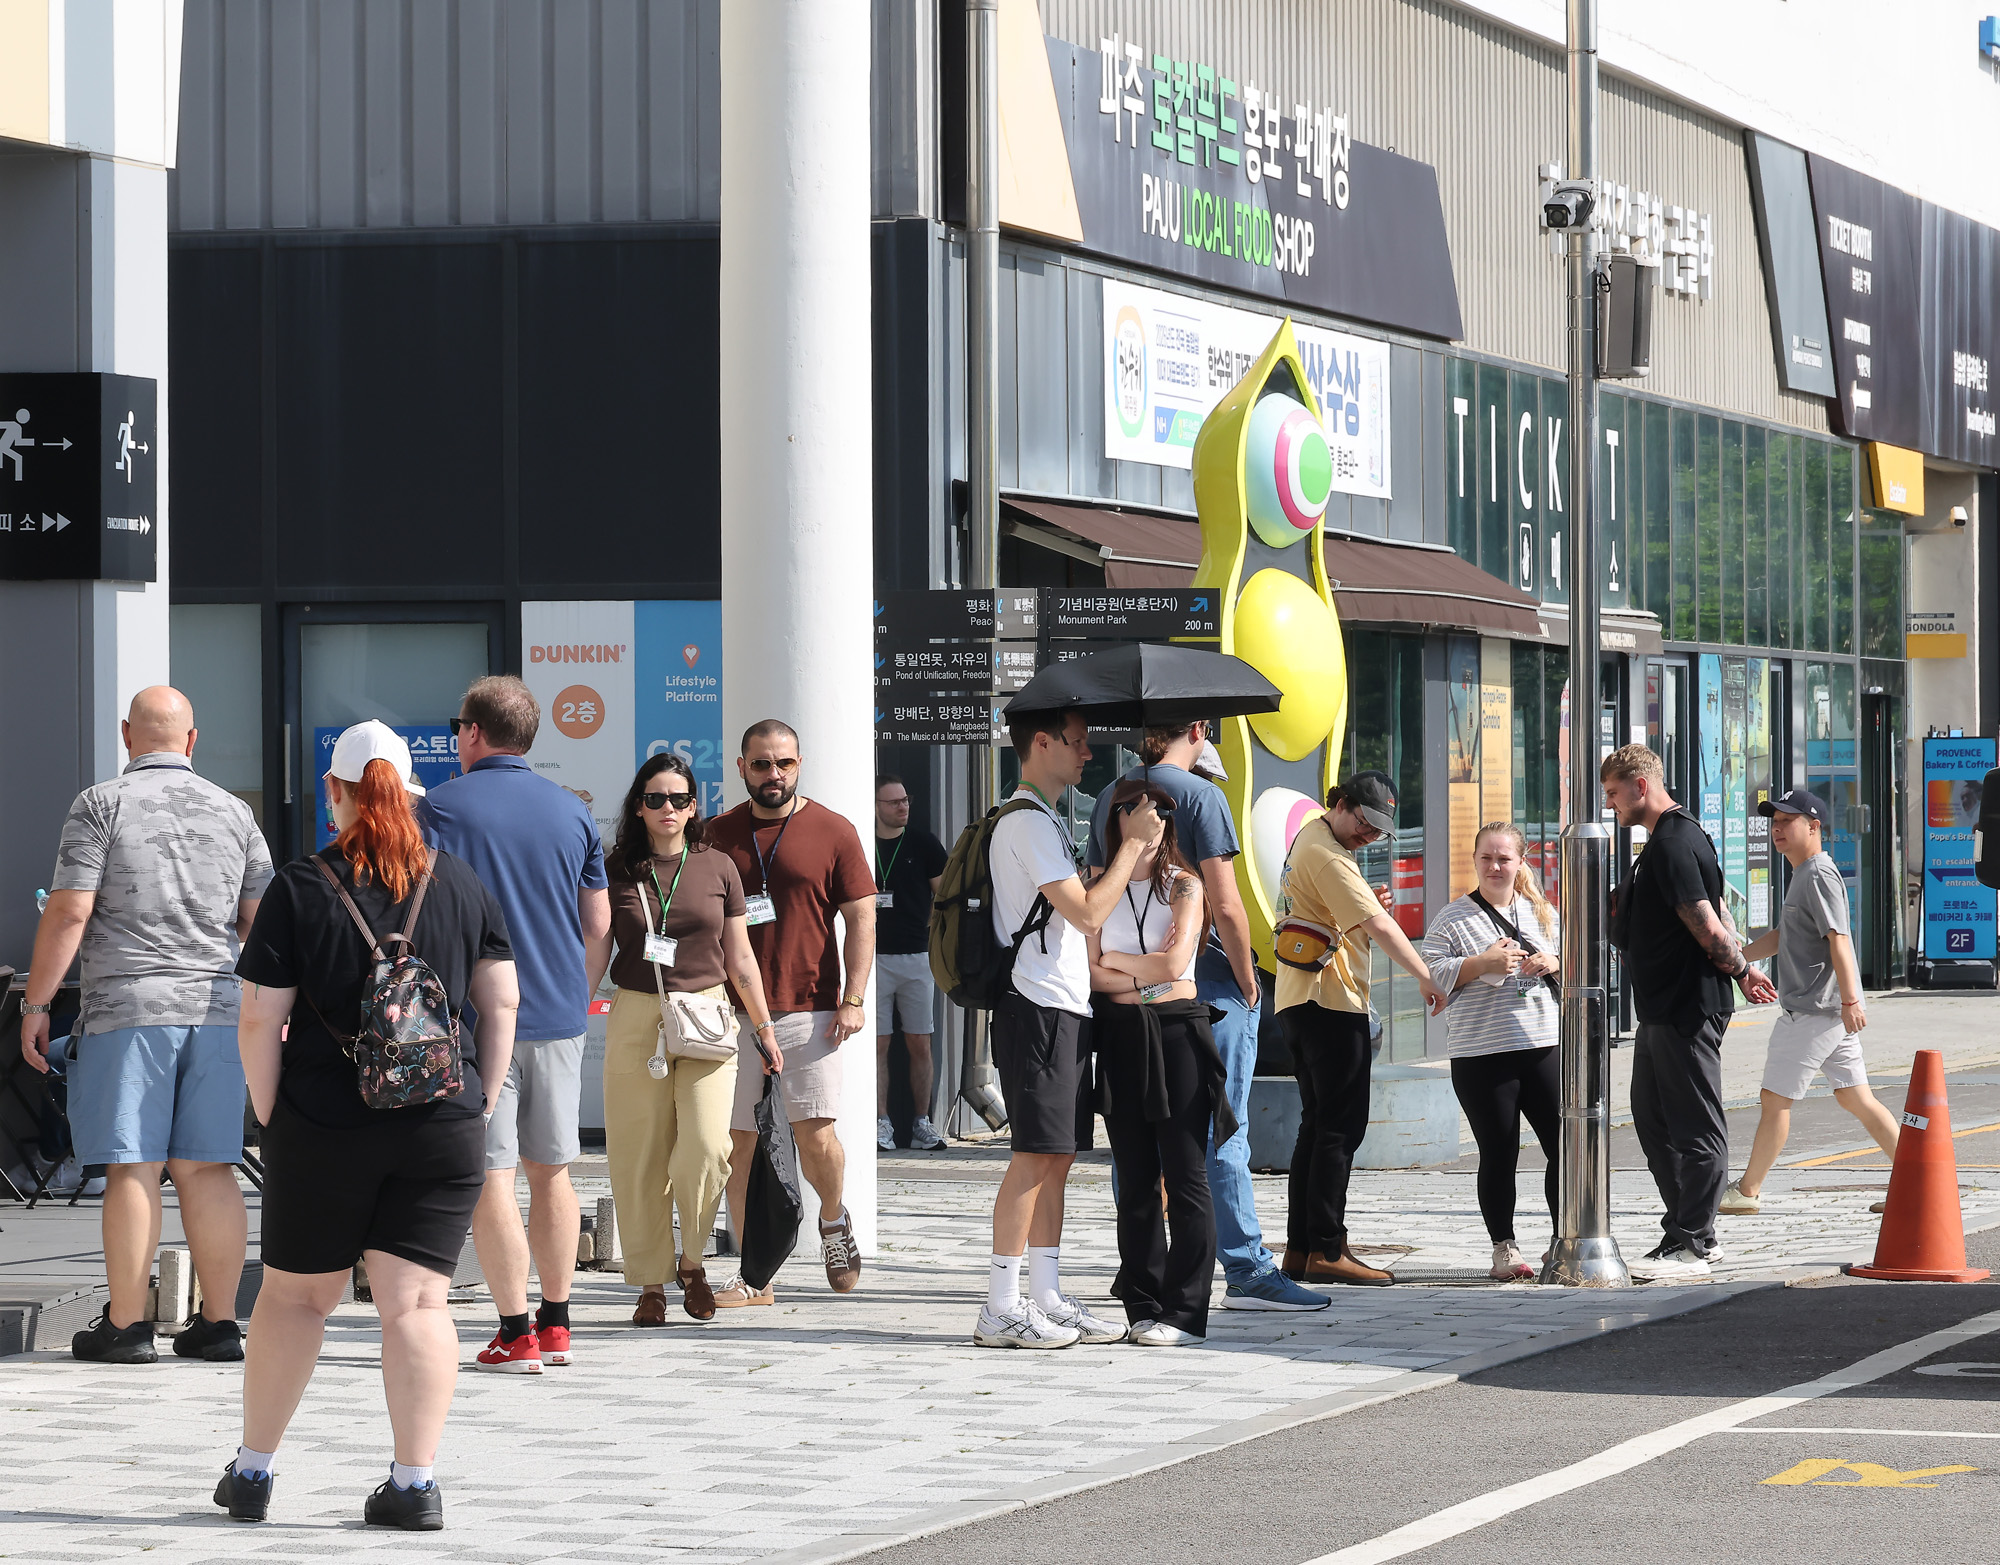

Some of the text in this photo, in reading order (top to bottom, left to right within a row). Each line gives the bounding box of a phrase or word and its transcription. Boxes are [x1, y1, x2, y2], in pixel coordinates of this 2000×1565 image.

[1099, 33, 1145, 149] 파주
[1151, 53, 1240, 168] 로컬푸드
[1141, 172, 1315, 277] PAJU LOCAL FOOD SHOP
[1207, 344, 1233, 390] 한수위
[1298, 339, 1361, 437] 상수상
[1156, 416, 1167, 434] NH
[1453, 396, 1619, 521] TICKT
[1551, 531, 1619, 592] 매소
[966, 599, 993, 614] 평화
[1058, 597, 1178, 612] 기념비공원(보훈단지)
[970, 616, 993, 626] Peac
[1058, 615, 1127, 625] Monument Park
[1184, 620, 1213, 631] 200 m
[1905, 622, 1955, 632] GONDOLA
[529, 644, 627, 664] DUNKIN'
[894, 652, 987, 668] 통일연못, 자유의
[895, 670, 913, 680] Pond
[914, 670, 922, 680] of
[923, 670, 960, 681] Unification,
[665, 675, 717, 689] Lifestyle
[665, 691, 717, 702] Platform
[561, 700, 597, 724] 2층
[894, 706, 934, 721] 망배단,
[938, 705, 974, 720] 망향의
[897, 732, 910, 741] The
[911, 731, 931, 741] Music
[932, 731, 940, 740] of
[1936, 748, 1982, 758] PROVENCE
[1925, 760, 1995, 770] Bakery & Coffee
[1929, 832, 1976, 842] Pope's Brea
[1931, 857, 1974, 866] TO escalat
[1945, 879, 1980, 887] entrance
[746, 903, 769, 914] Eddie
[1943, 901, 1978, 910] 프로방스
[1929, 912, 1993, 922] 베이커리 & 카페
[1950, 932, 1970, 948] 2F
